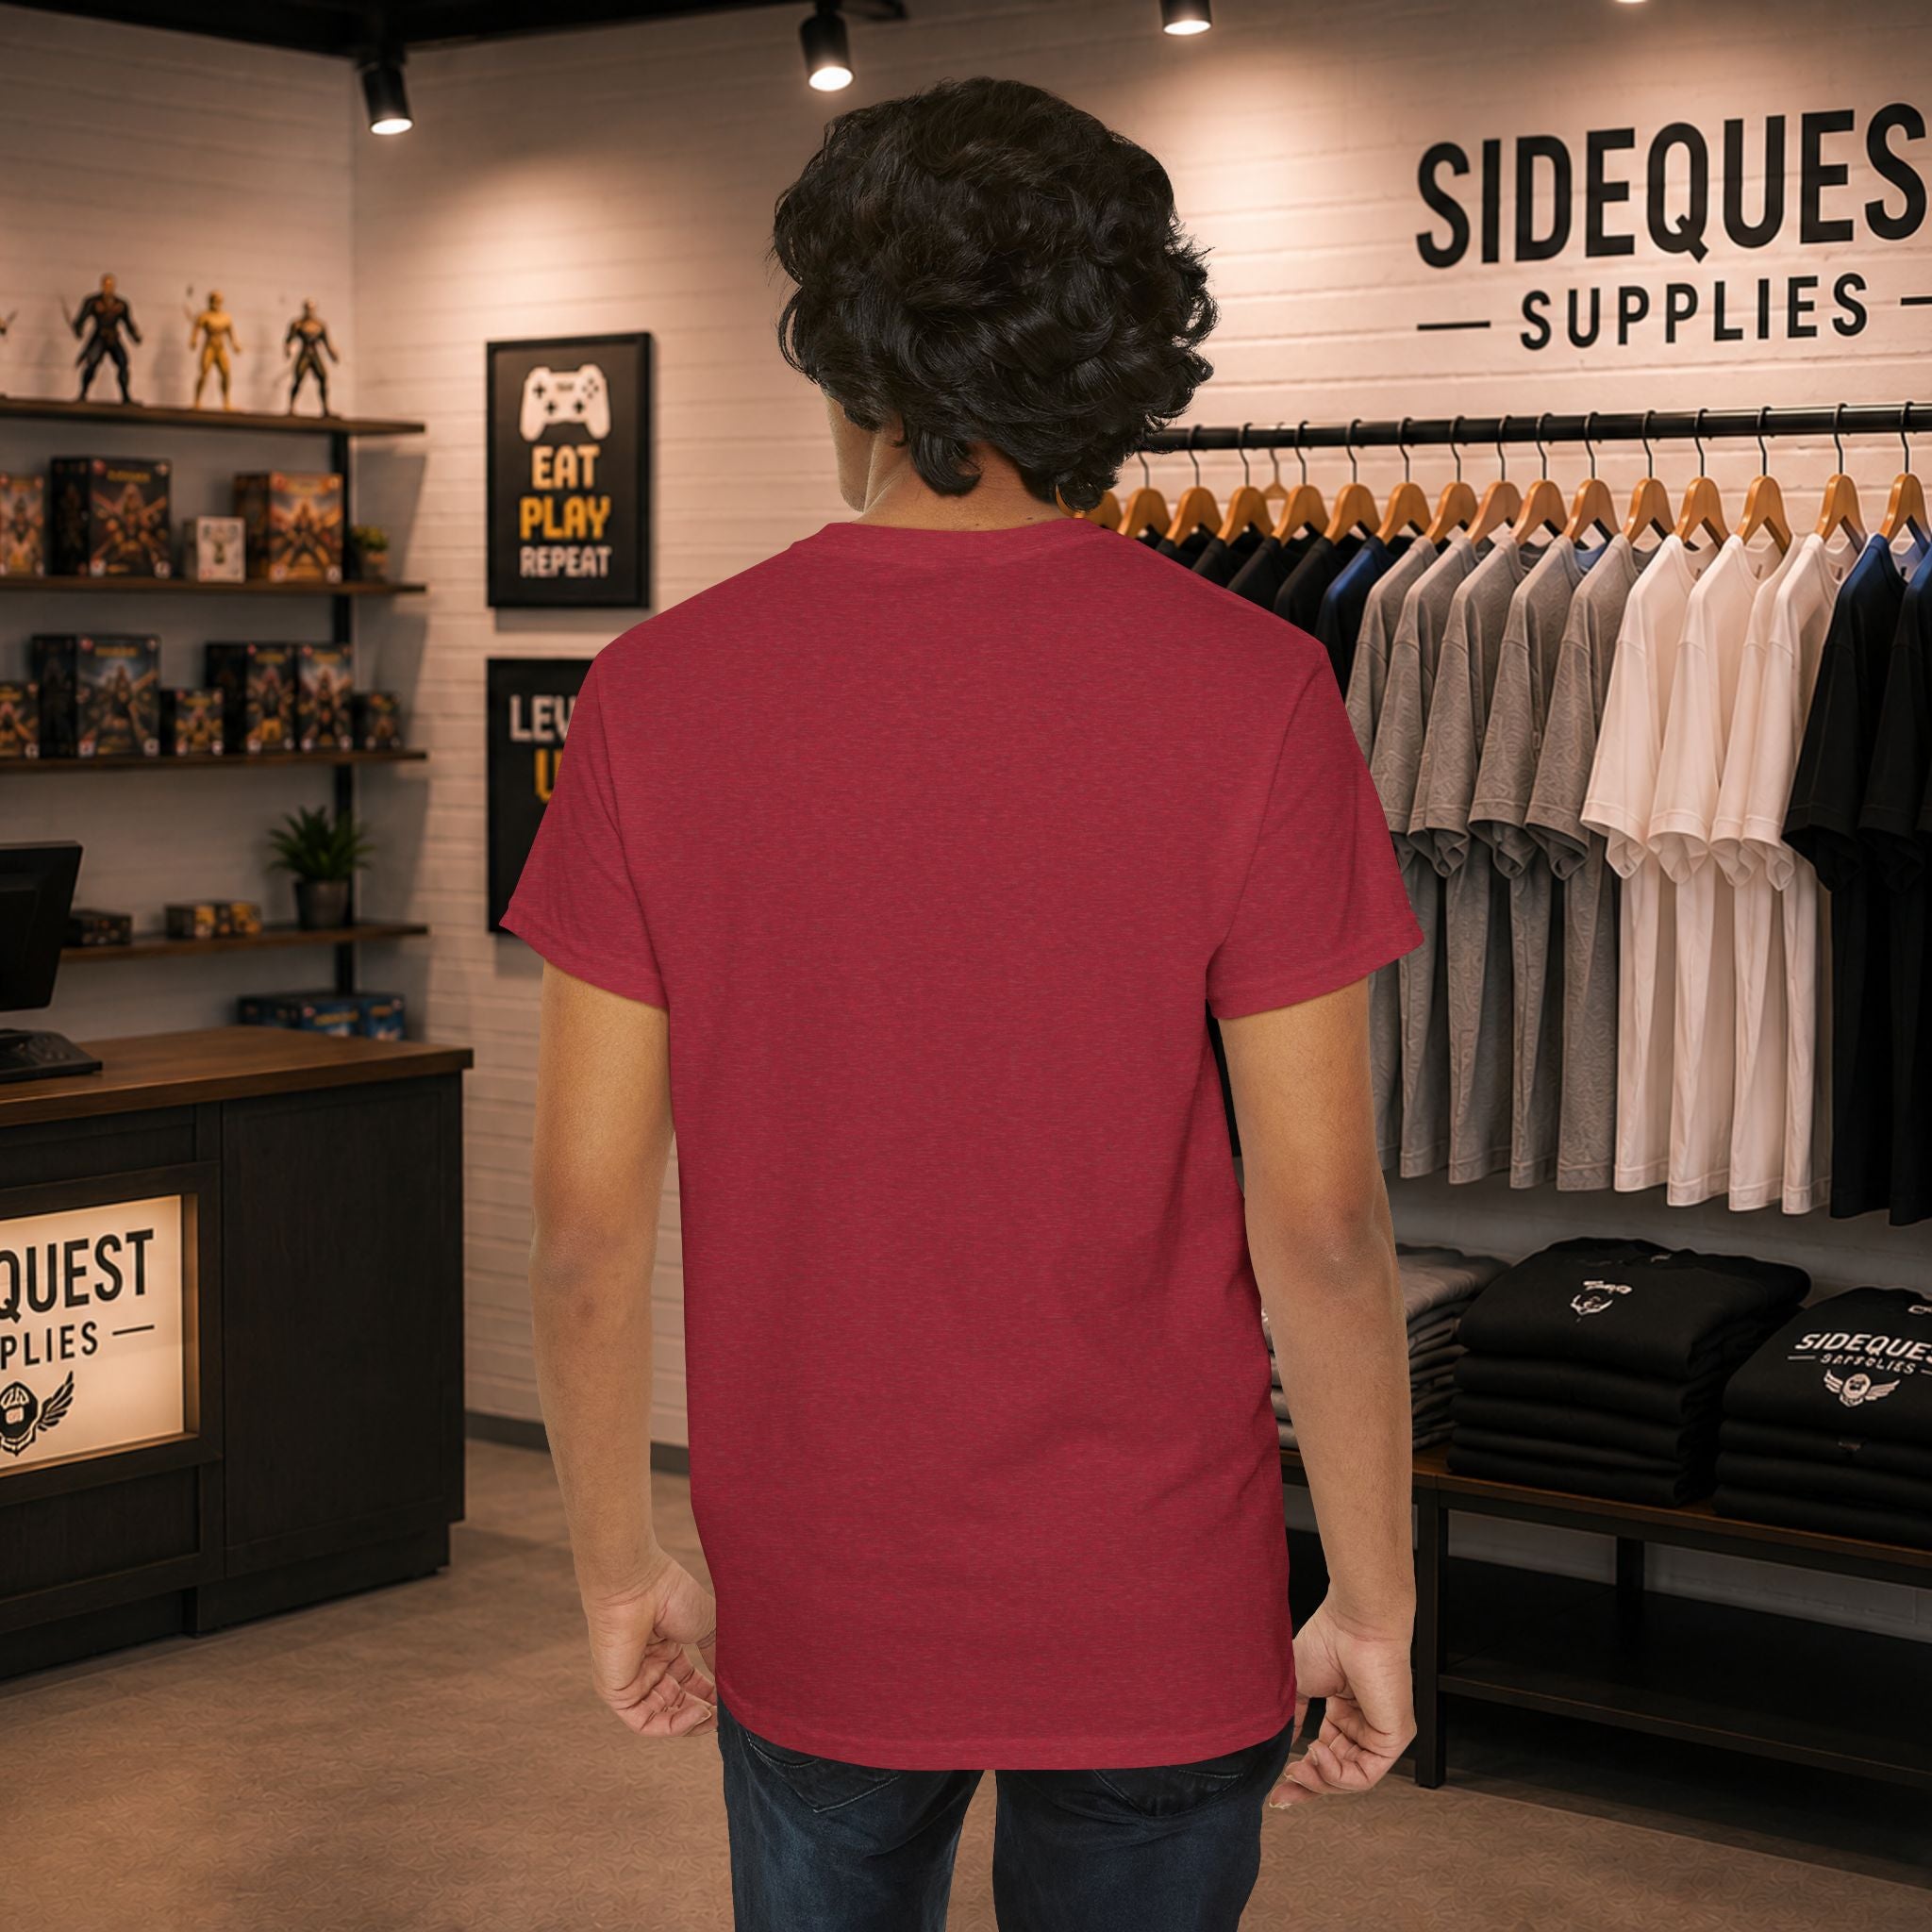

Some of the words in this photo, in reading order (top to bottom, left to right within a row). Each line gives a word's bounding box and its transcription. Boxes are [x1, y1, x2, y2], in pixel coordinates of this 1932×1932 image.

[1415, 102, 1927, 269] SIDEQUES
[1520, 273, 1868, 351] SUPPLIES
[532, 444, 601, 490] EAT
[520, 495, 611, 541] PLAY
[520, 545, 612, 577] REPEAT
[0, 1321, 98, 1370] PLIES
[1794, 1332, 1932, 1364] SIDEQUE
